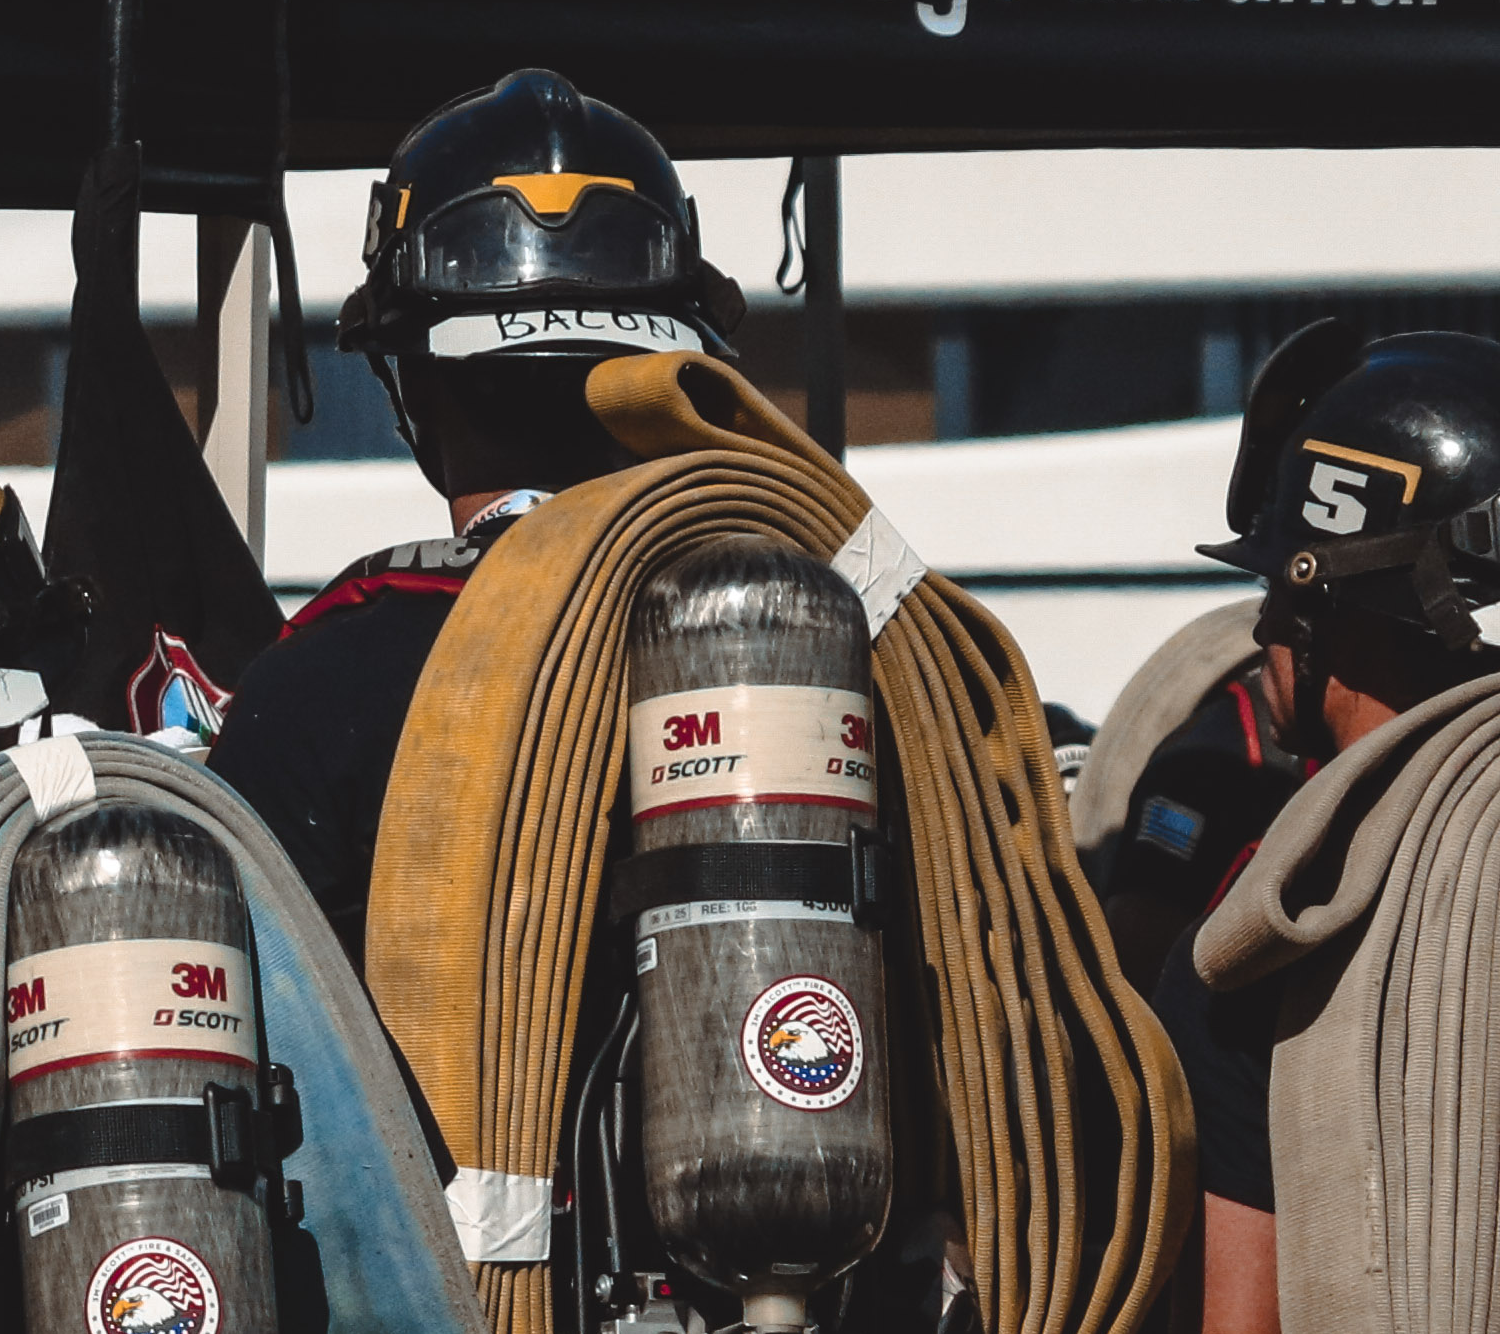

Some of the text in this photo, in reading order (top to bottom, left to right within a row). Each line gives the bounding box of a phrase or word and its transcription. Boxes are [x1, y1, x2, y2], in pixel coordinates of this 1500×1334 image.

[1301, 461, 1369, 536] 5
[663, 710, 721, 751] 3M
[667, 754, 739, 778] SCOTT
[7, 963, 228, 1024] 3M 3M
[178, 1008, 242, 1035] SCOTT
